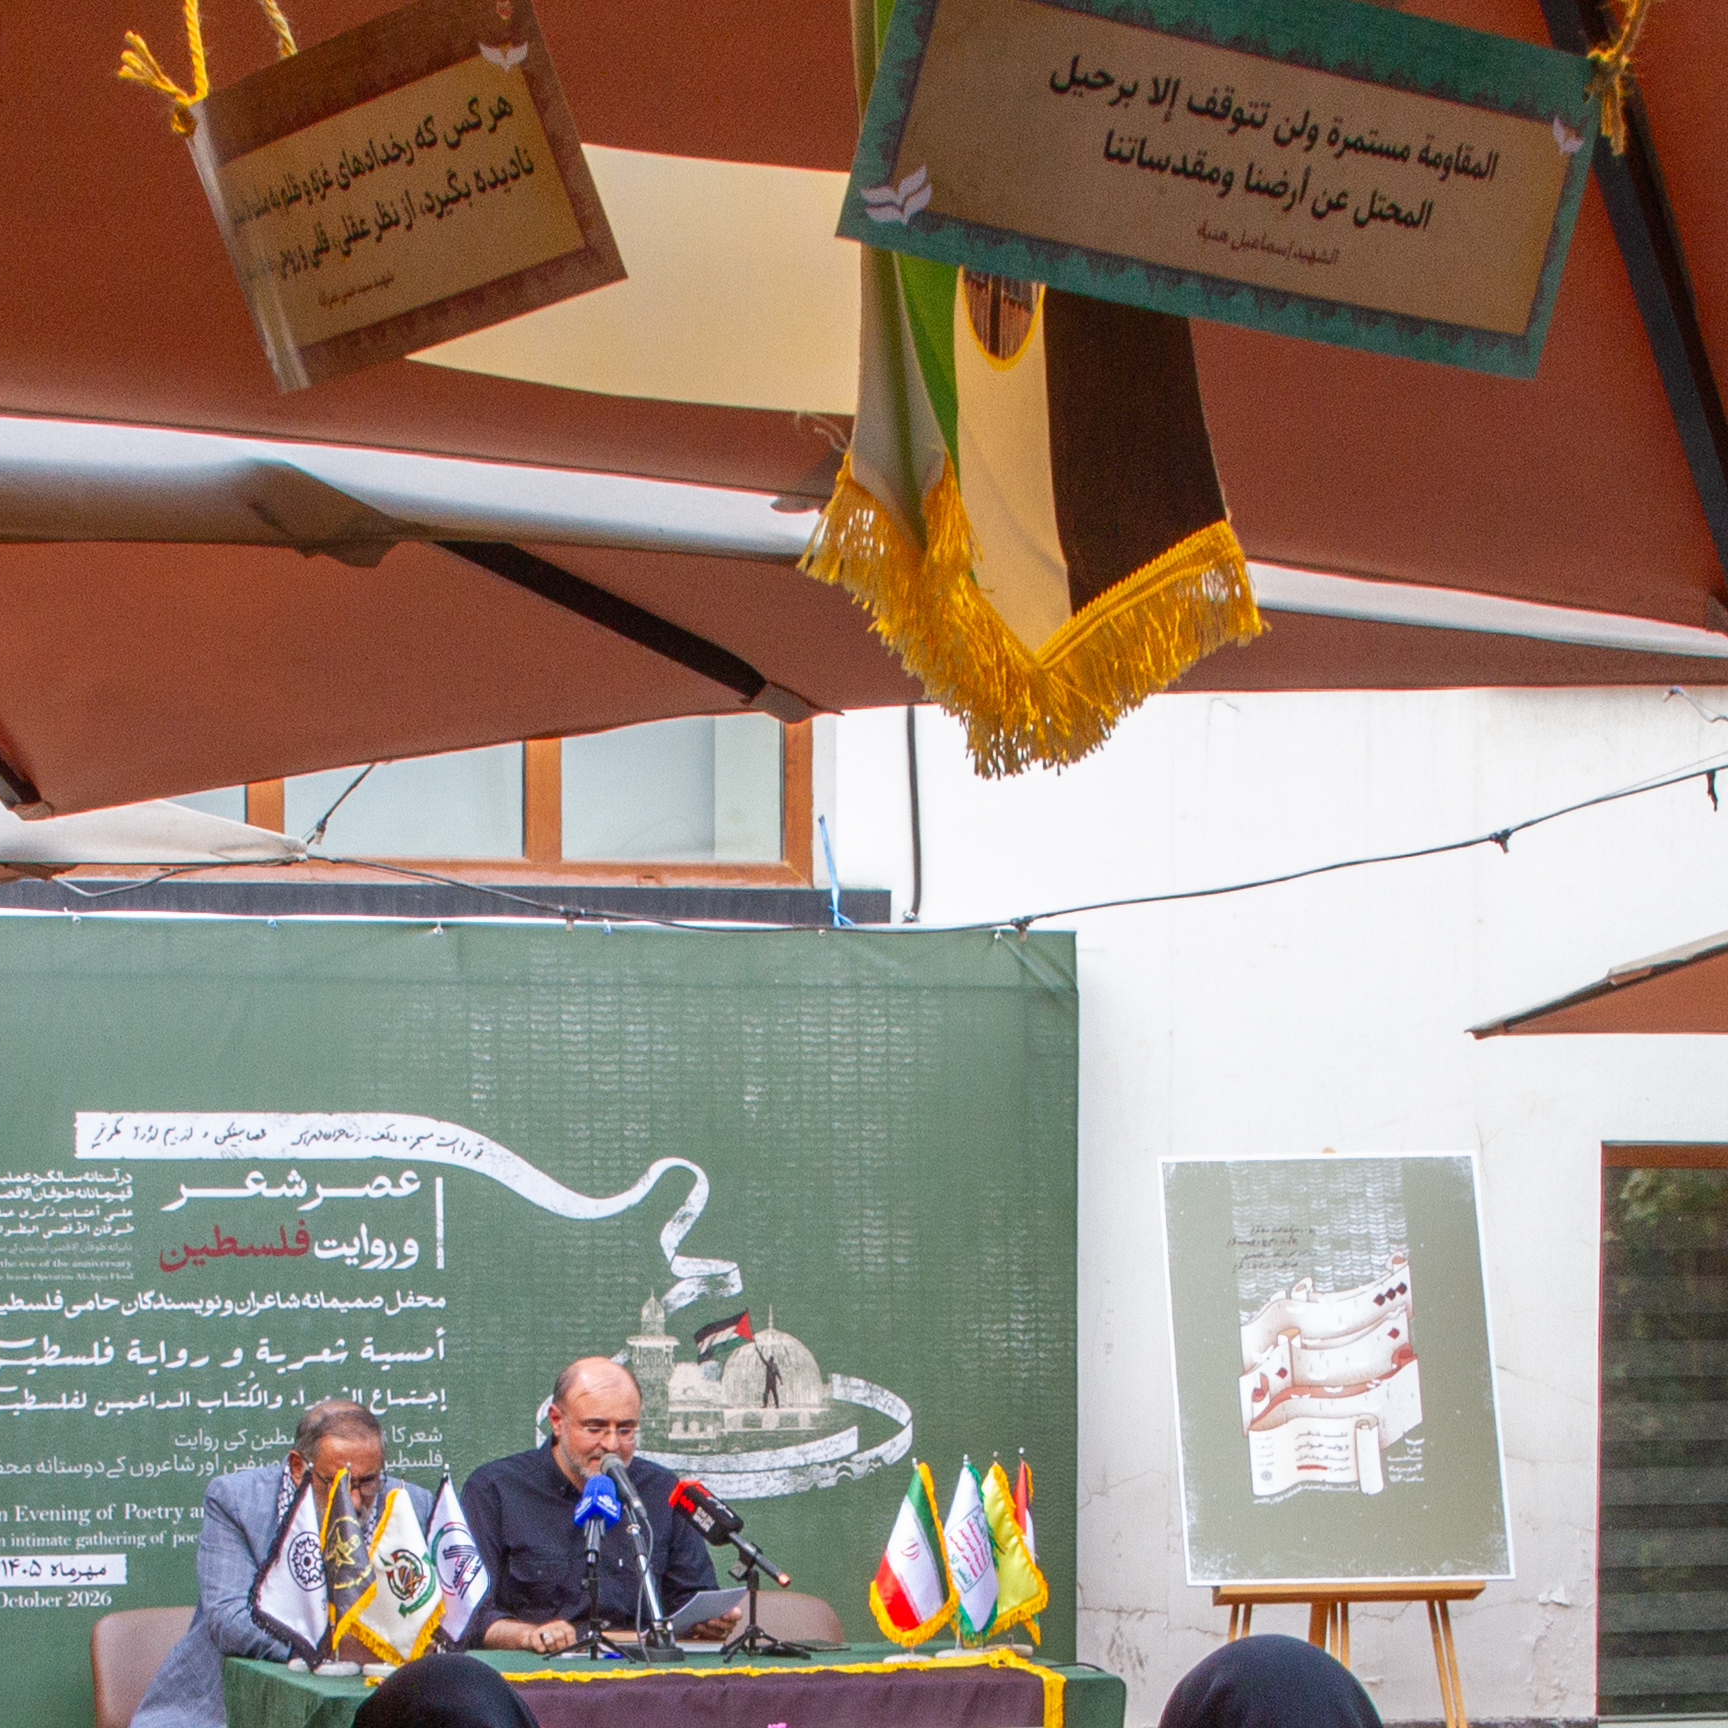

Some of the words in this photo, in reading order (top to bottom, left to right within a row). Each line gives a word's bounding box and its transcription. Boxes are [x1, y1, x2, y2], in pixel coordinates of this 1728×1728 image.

[1050, 55, 1138, 107] برحيل
[1148, 77, 1180, 122] إلا
[1187, 88, 1270, 135] تتوقف
[444, 97, 483, 149] کس
[488, 98, 513, 133] هر
[415, 116, 437, 149] که
[1273, 110, 1319, 152] ولن
[1327, 118, 1410, 163] مستمرة
[337, 132, 414, 190] رخدادهای
[474, 147, 534, 193] نادیده
[1104, 130, 1234, 198] ومقدساتنا
[1417, 135, 1499, 182] المقاومة
[1244, 163, 1310, 212] أرضنا
[401, 190, 416, 231] از
[1311, 191, 1348, 220] عن
[1353, 191, 1433, 229] المحتل
[375, 202, 400, 243] نظر
[31, 1170, 82, 1186] سالگرد
[81, 1168, 119, 1182] آستانه
[115, 1172, 132, 1187] در
[31, 1185, 76, 1202] طوفان
[162, 1170, 309, 1211] شعر
[297, 1171, 420, 1210] عصر
[59, 1205, 100, 1218] أعتاب
[104, 1209, 133, 1222] على
[158, 1218, 311, 1273] فلسطین
[314, 1224, 398, 1269] روایت
[393, 1238, 419, 1269] و
[0, 1258, 16, 1267] the
[52, 1258, 70, 1267] the
[65, 1293, 119, 1318] حامی
[121, 1290, 222, 1316] نویسندگان
[235, 1292, 300, 1316] شاعران
[302, 1291, 386, 1313] صمیمانه
[385, 1291, 446, 1315] محفل
[127, 1339, 209, 1375] رواية
[221, 1348, 243, 1367] و
[256, 1338, 348, 1373] شعرية
[361, 1327, 445, 1370] أمسية
[94, 1392, 190, 1416] الداعمين
[370, 1389, 447, 1415] إجتماع
[175, 1428, 219, 1451] روایت
[224, 1429, 247, 1451] کی
[250, 1426, 295, 1451] طین
[392, 1425, 406, 1443] کا
[407, 1427, 442, 1447] شعر
[130, 1454, 195, 1477] شاعروں
[197, 1454, 219, 1476] اور
[384, 1448, 443, 1471] فلسطی
[15, 1505, 91, 1526] Evening
[96, 1504, 116, 1520] of
[125, 1503, 183, 1524] Poetry
[12, 1532, 71, 1547] intimate
[76, 1531, 146, 1550] gathering
[150, 1531, 166, 1544] of
[2, 1559, 41, 1576] ۱۴۰۵
[51, 1565, 106, 1582] مهرماه
[68, 1591, 111, 1606] 2026
